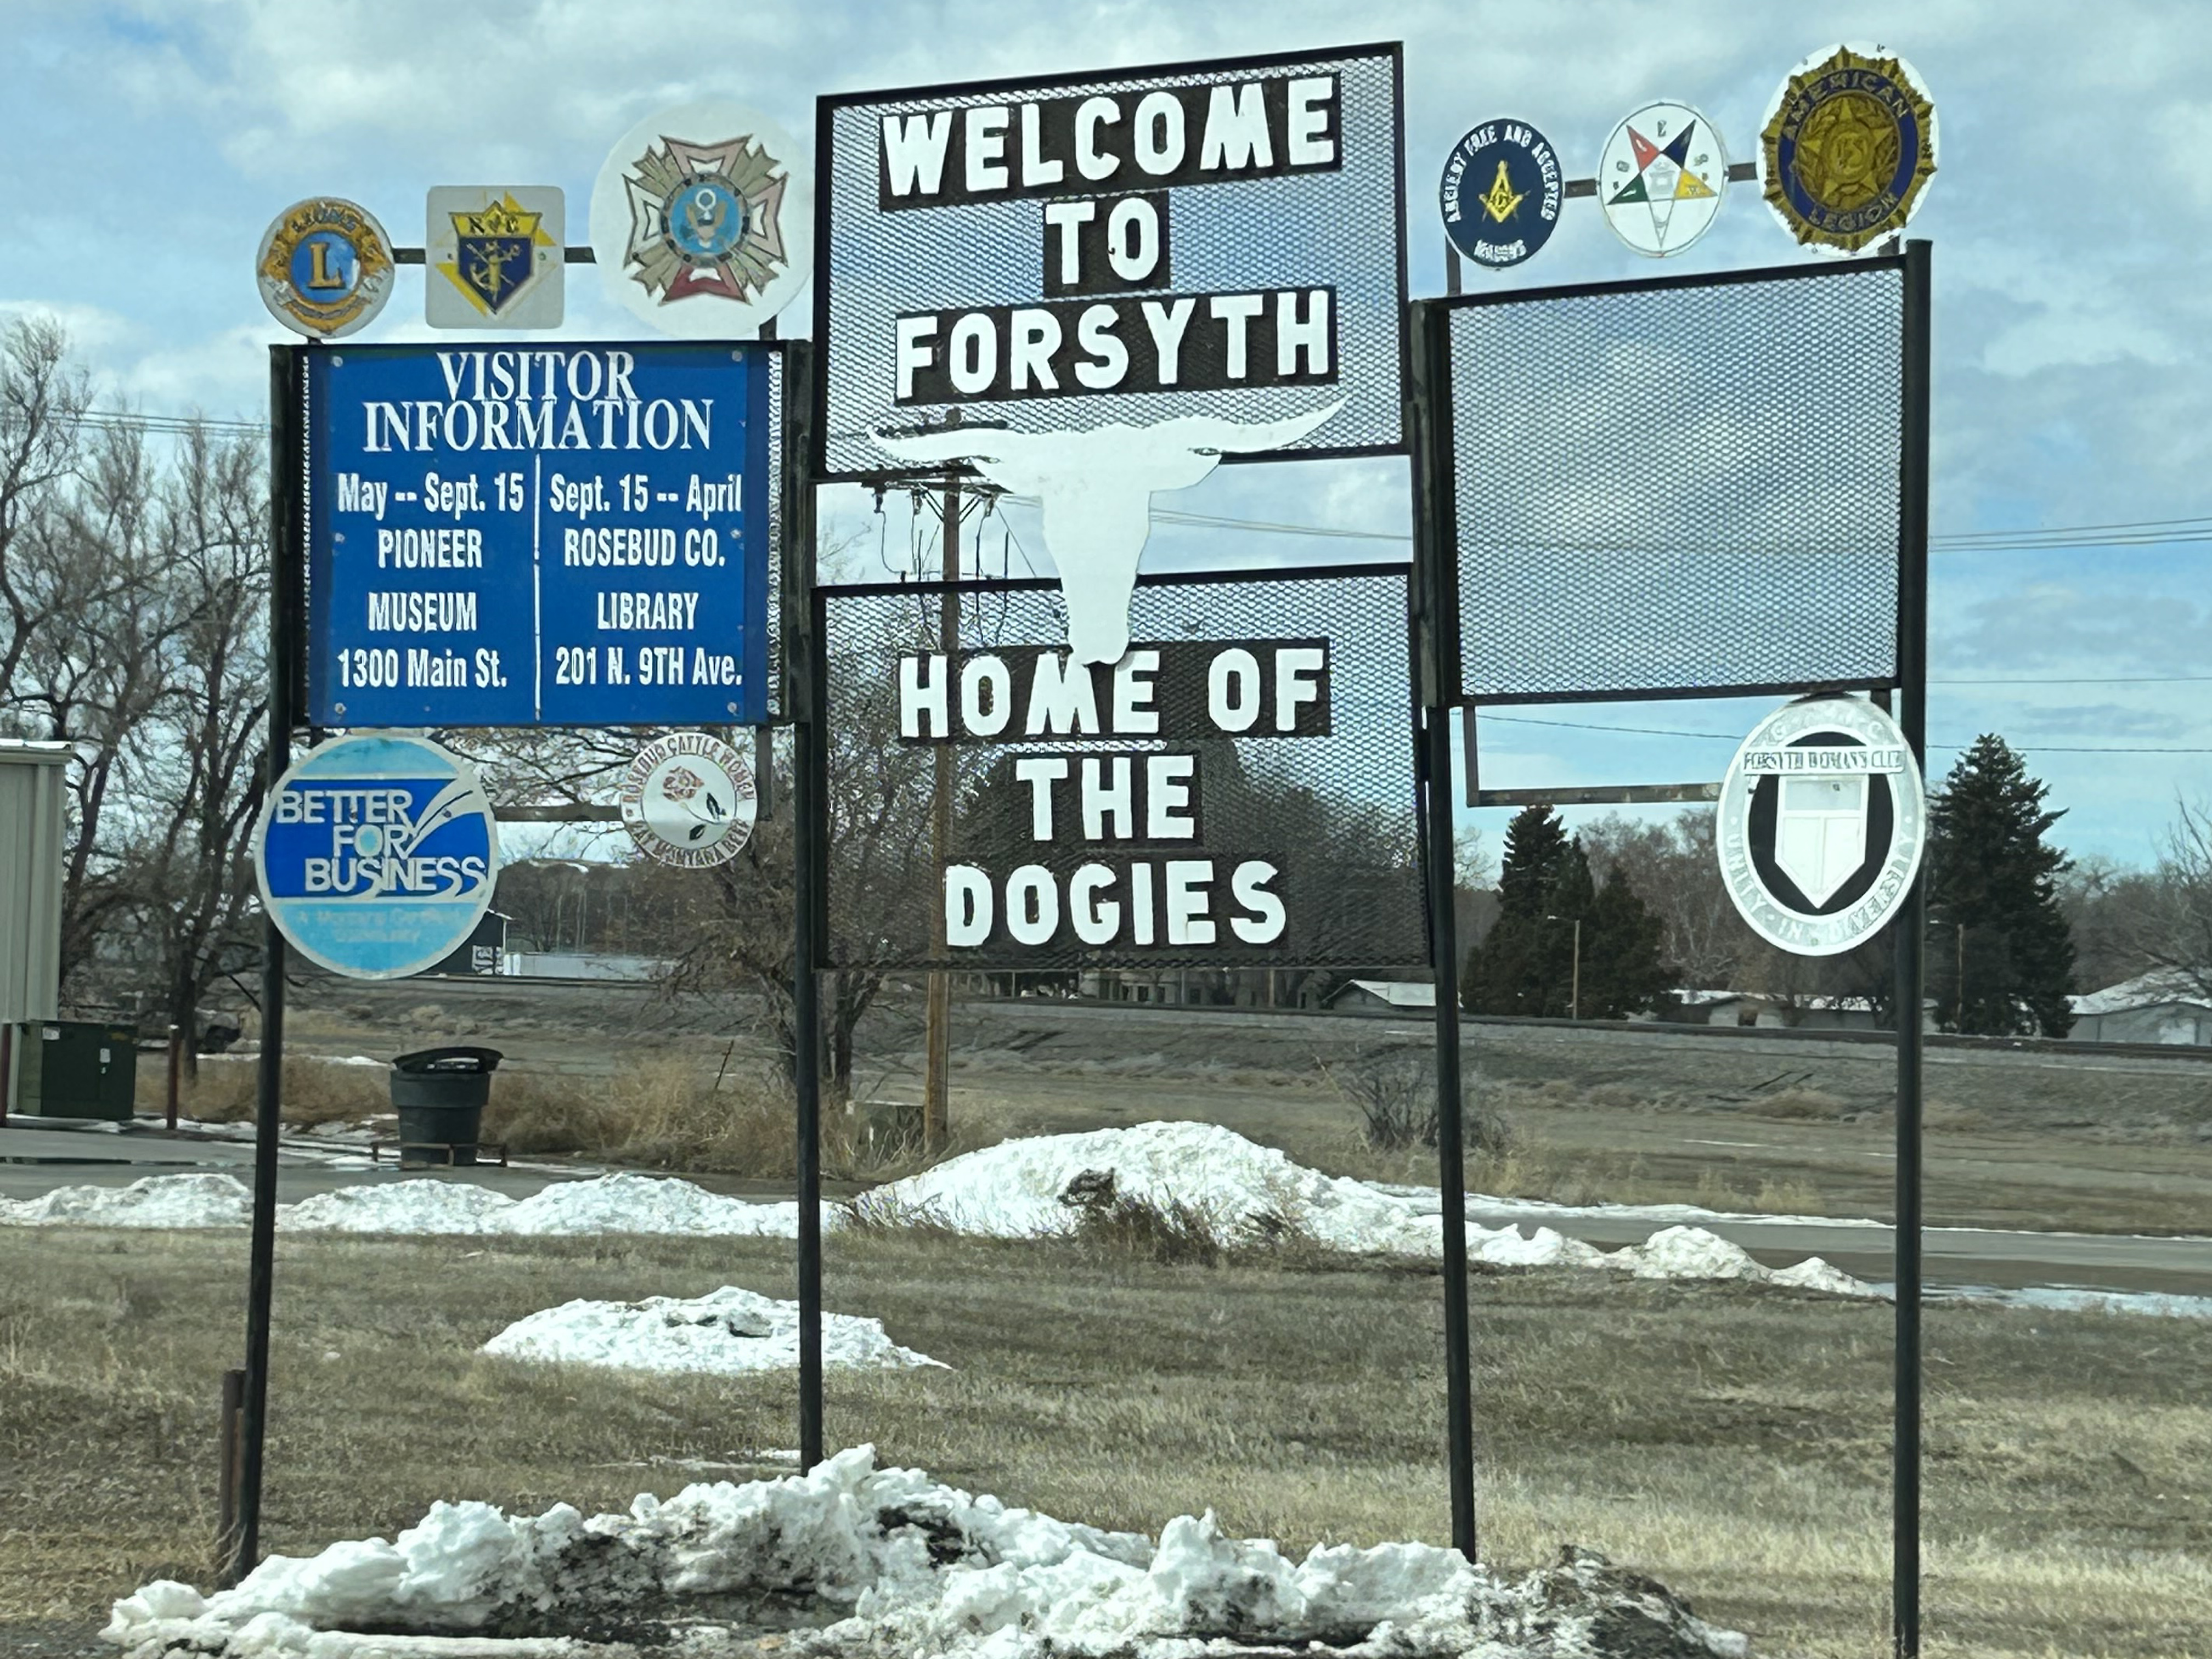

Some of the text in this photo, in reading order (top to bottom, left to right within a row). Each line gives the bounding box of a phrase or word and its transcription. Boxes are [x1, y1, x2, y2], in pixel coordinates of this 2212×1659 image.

[1783, 75, 1908, 140] AMERICAN
[883, 76, 1335, 196] WELCOME
[1504, 125, 1532, 148] AND
[1809, 192, 1898, 231] LEGION
[1045, 196, 1160, 285] TO
[308, 242, 346, 287] L
[896, 290, 1329, 399] FORSYTH
[438, 351, 637, 400] VISITOR
[363, 399, 713, 452] INFORMATION
[338, 474, 388, 521] May
[425, 473, 486, 521] Sept.
[495, 473, 524, 512] 15
[550, 474, 610, 520] Sept.
[620, 475, 648, 512] 15
[687, 475, 742, 521] April
[379, 529, 482, 568] PIONEER
[566, 529, 725, 567] ROSEBUD CO.
[369, 593, 477, 633] MUSEUM
[599, 593, 699, 630] LIBRARY
[338, 649, 507, 688] 1300 Main St.
[557, 647, 742, 685] 201 N. 9TH Ave.
[900, 648, 1324, 737] HOME OF
[276, 789, 415, 826] BETTER
[1015, 754, 1195, 841] THE
[332, 824, 410, 859] FOR
[304, 856, 488, 895] BUSINESS
[945, 860, 1287, 946] DOGIES
